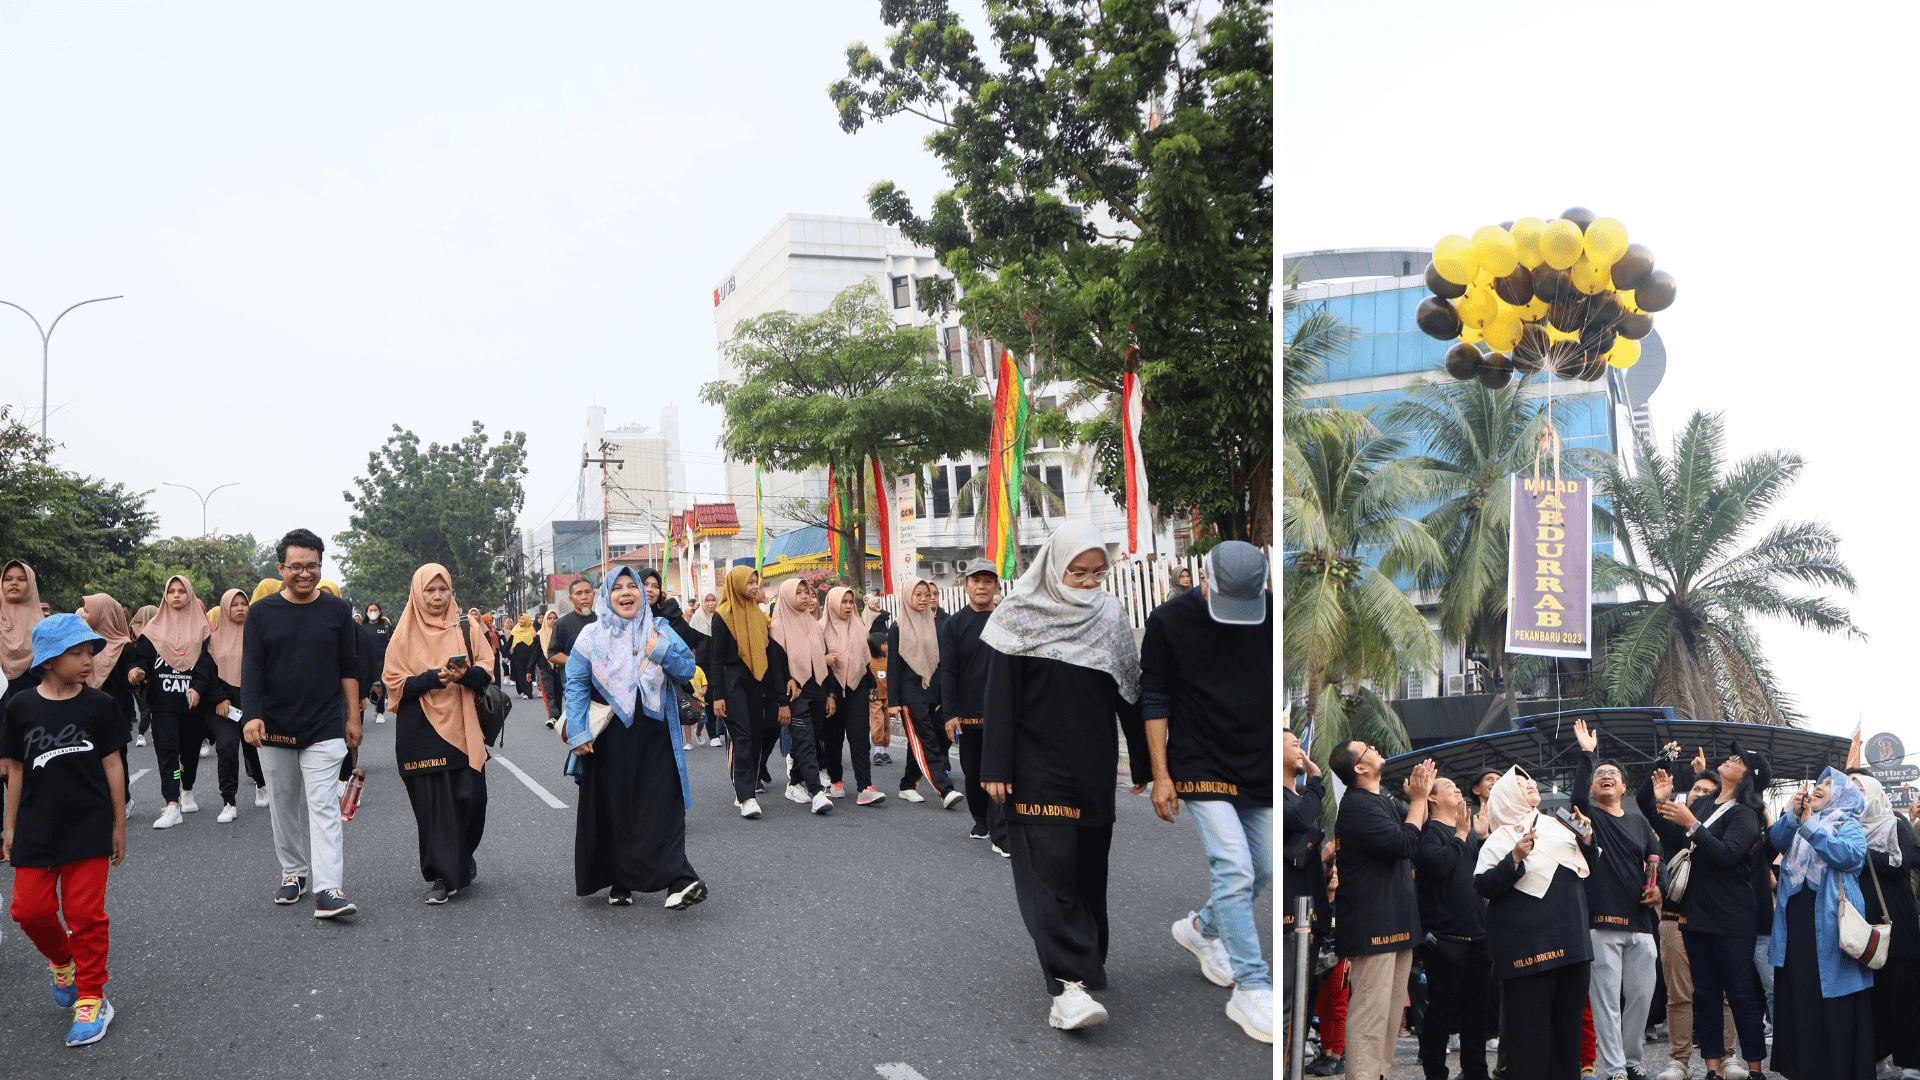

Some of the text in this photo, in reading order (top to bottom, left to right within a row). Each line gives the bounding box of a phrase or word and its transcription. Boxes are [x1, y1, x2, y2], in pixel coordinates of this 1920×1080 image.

[1524, 478, 1578, 493] MILAD
[1533, 494, 1566, 627] ABDURRAB
[1515, 629, 1582, 644] PEKANBARU 2023
[23, 723, 91, 760] Polo
[57, 747, 80, 755] LAUREN
[418, 757, 447, 768] ABDURRAB
[1869, 768, 1919, 777] rother's
[1194, 780, 1238, 796] ABDURRAB
[1015, 803, 1080, 819] MILAD ABDURRAB
[1371, 936, 1390, 945] MILAD
[1513, 949, 1565, 968] MILAD ABDURRAB
